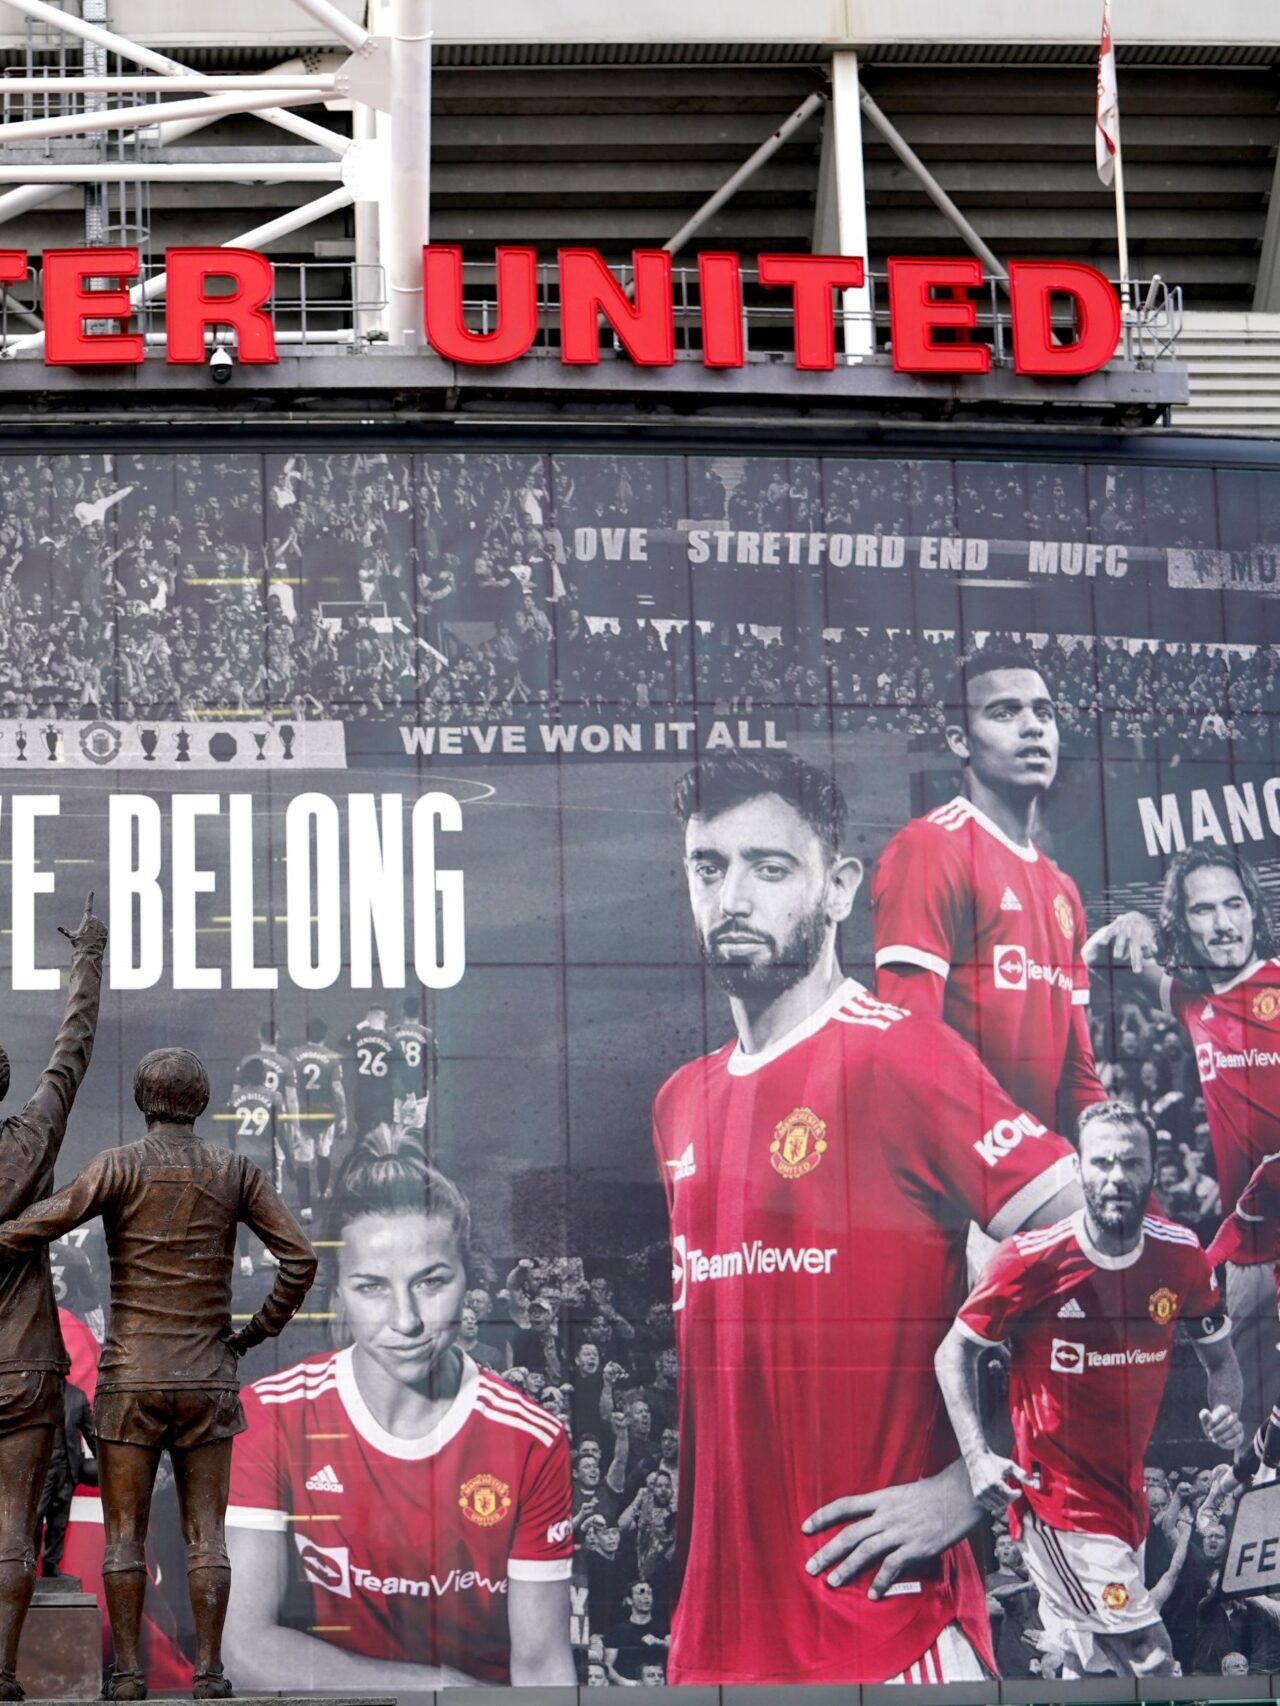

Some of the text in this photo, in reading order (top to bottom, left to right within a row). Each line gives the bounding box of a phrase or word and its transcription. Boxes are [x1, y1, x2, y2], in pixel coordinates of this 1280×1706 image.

[423, 244, 1122, 378] UNITED
[574, 527, 648, 562] OVE
[687, 530, 905, 568] STRETFORD
[919, 537, 988, 571] END
[1028, 541, 1128, 578] MUFC
[400, 720, 788, 755] WE'VE WON IT ALL
[109, 792, 466, 990] BELONG
[303, 1063, 321, 1090] 2
[357, 1049, 388, 1077] 26
[236, 1107, 270, 1136] 29
[687, 1240, 838, 1283] TeamViewer
[1201, 1316, 1215, 1334] C
[1086, 1348, 1168, 1367] TeamViewer
[1236, 1537, 1280, 1578] FE
